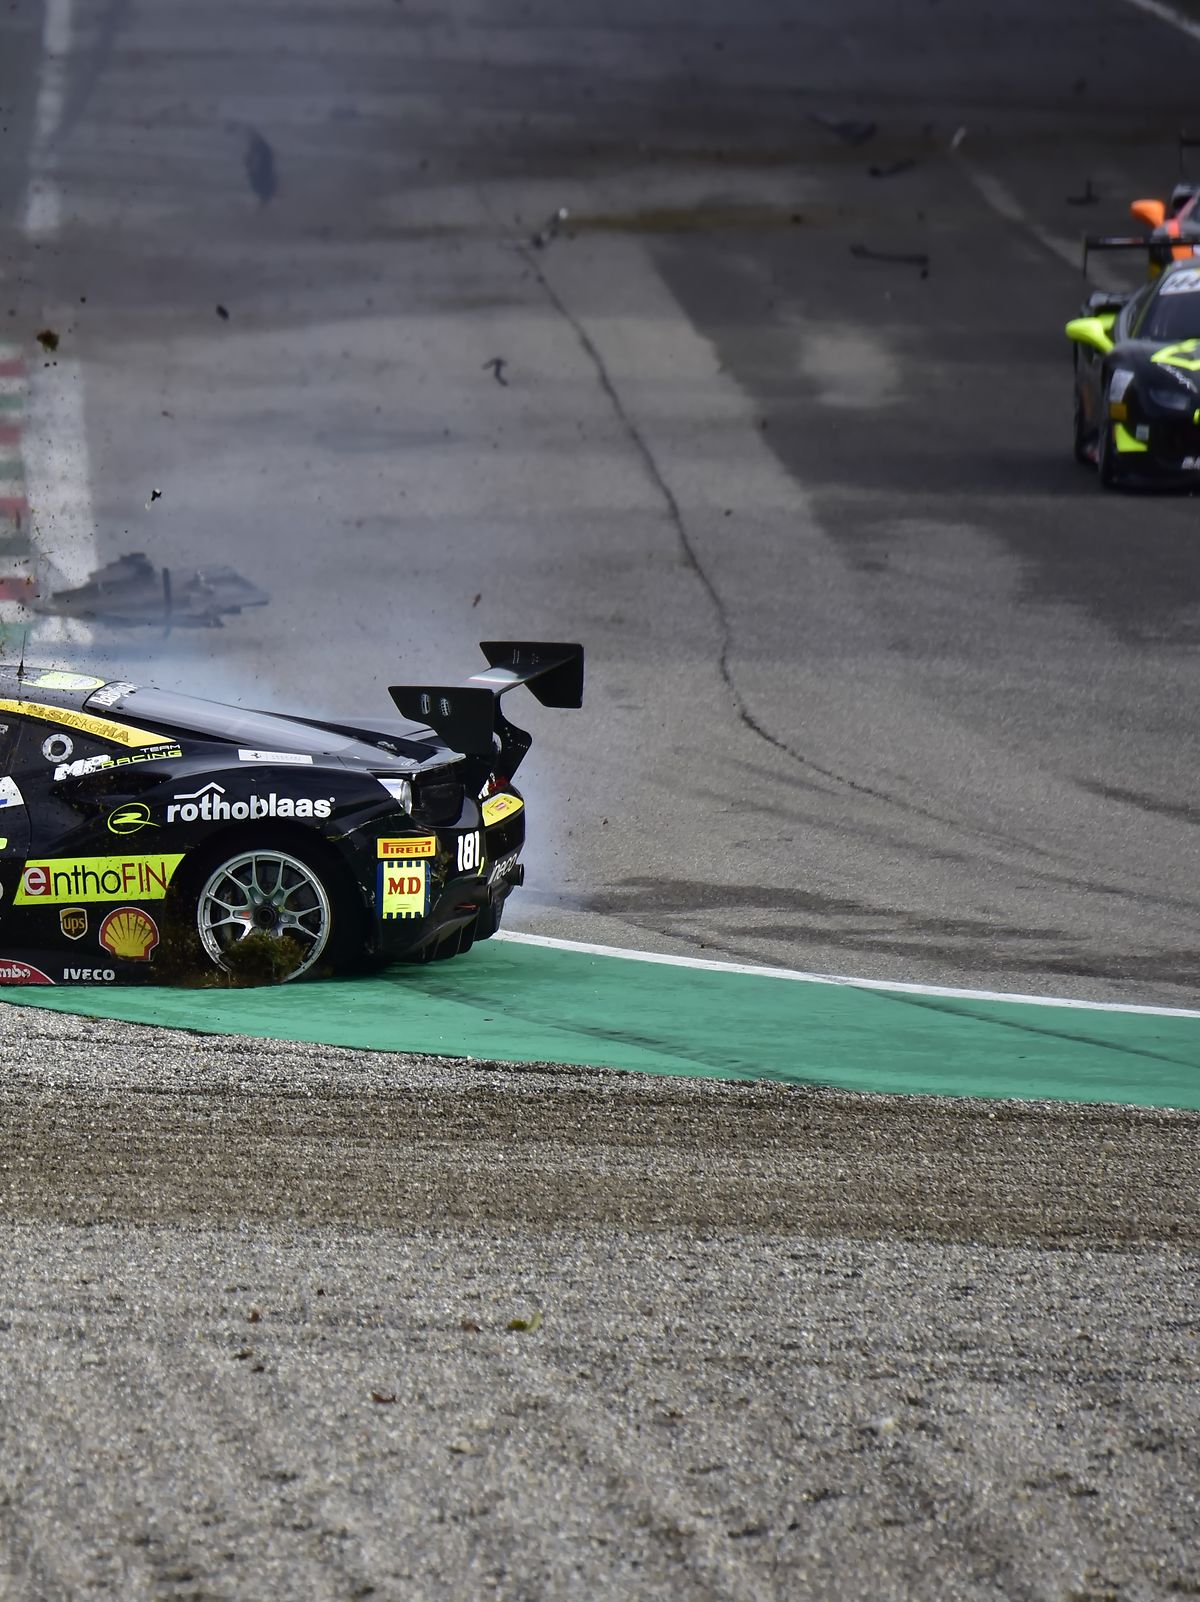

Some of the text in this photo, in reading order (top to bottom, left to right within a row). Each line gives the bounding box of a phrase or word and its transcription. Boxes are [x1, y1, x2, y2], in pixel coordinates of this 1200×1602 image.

[45, 709, 129, 743] SINGHA
[140, 744, 181, 754] TEAM
[101, 750, 182, 769] RACING
[167, 793, 332, 823] rothoblaas
[383, 841, 432, 854] PIRELLI
[457, 831, 480, 872] 181
[487, 853, 518, 885] ineco
[24, 862, 168, 896] enthoFIN
[388, 877, 421, 896] MD
[63, 916, 86, 935] ups
[64, 968, 116, 981] IVECO
